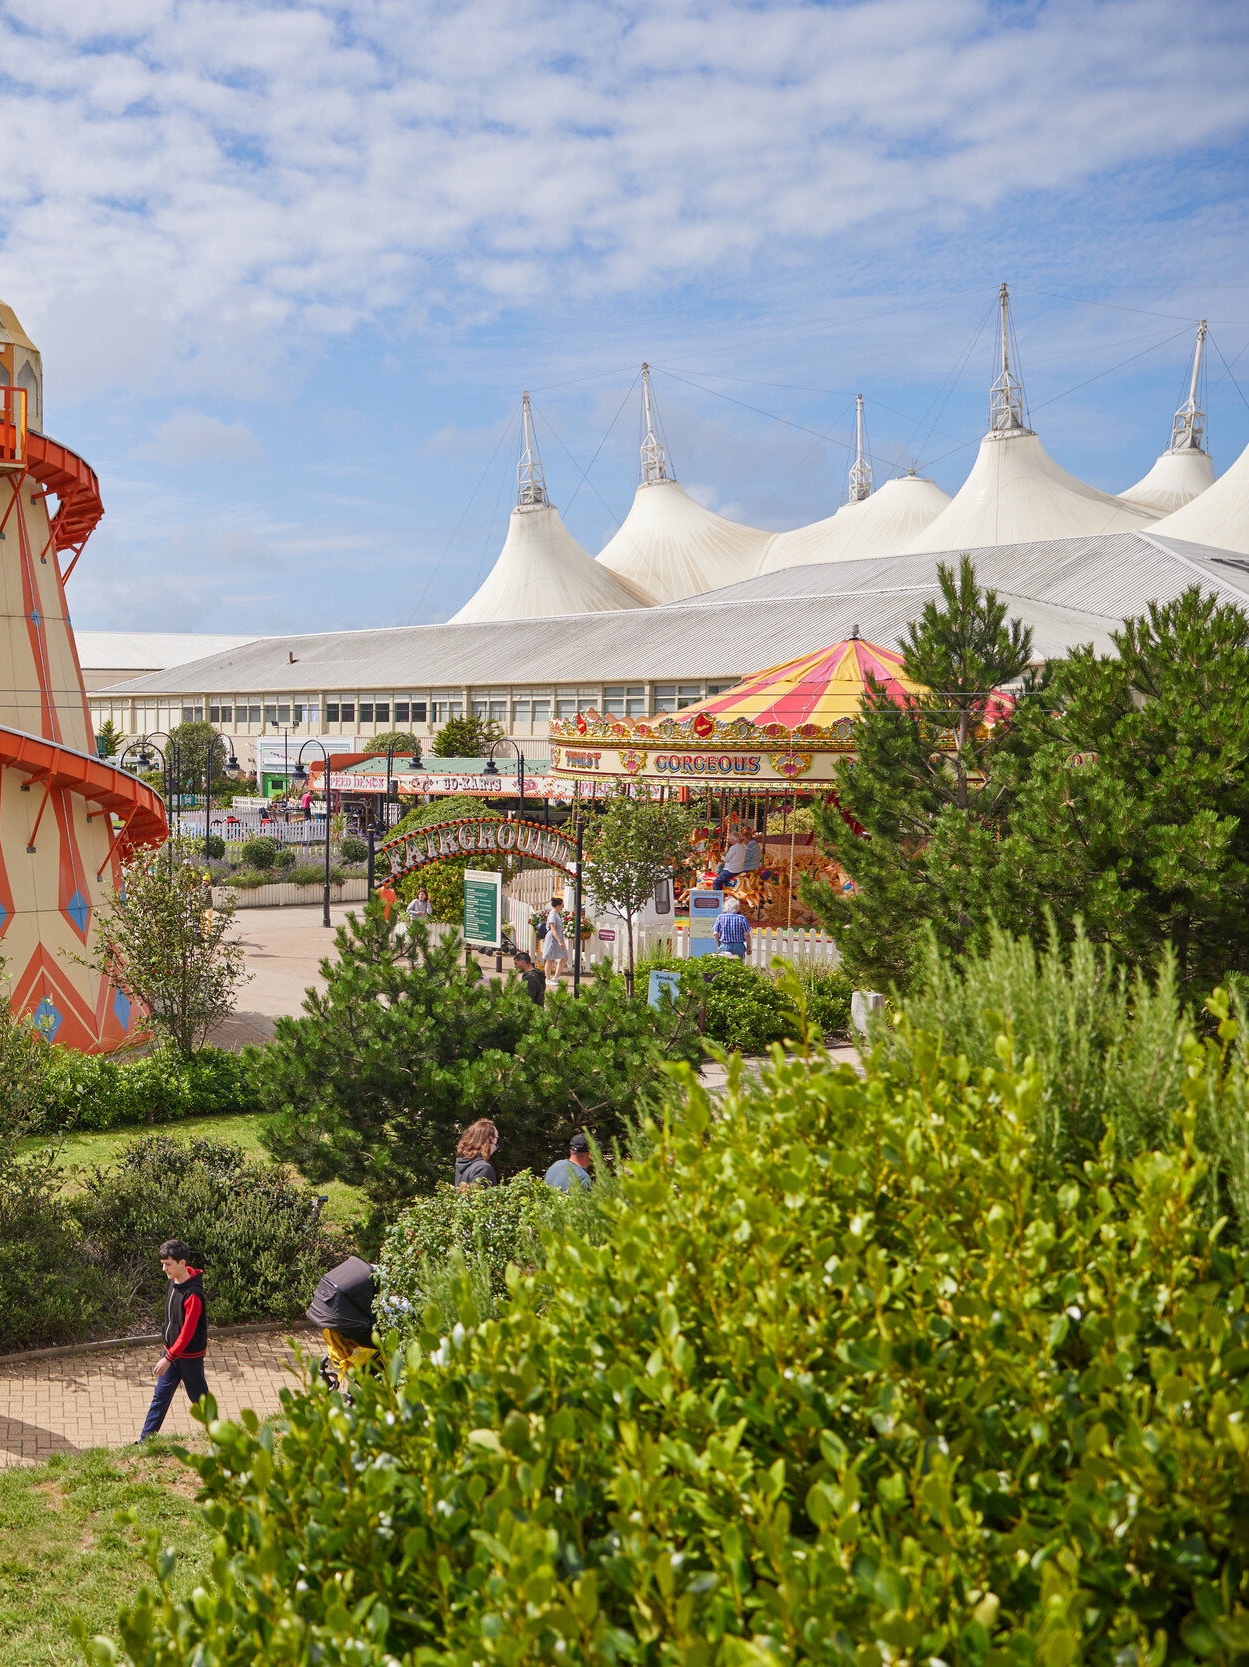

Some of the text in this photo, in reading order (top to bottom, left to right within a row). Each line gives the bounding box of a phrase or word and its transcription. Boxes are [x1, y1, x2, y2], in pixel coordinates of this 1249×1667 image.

[565, 750, 601, 769] FINEST
[654, 754, 761, 775] GORGEOUS
[326, 776, 384, 789] PEED DEMON
[443, 776, 502, 791] GO-KARTS
[383, 822, 571, 875] FAIRGROUND
